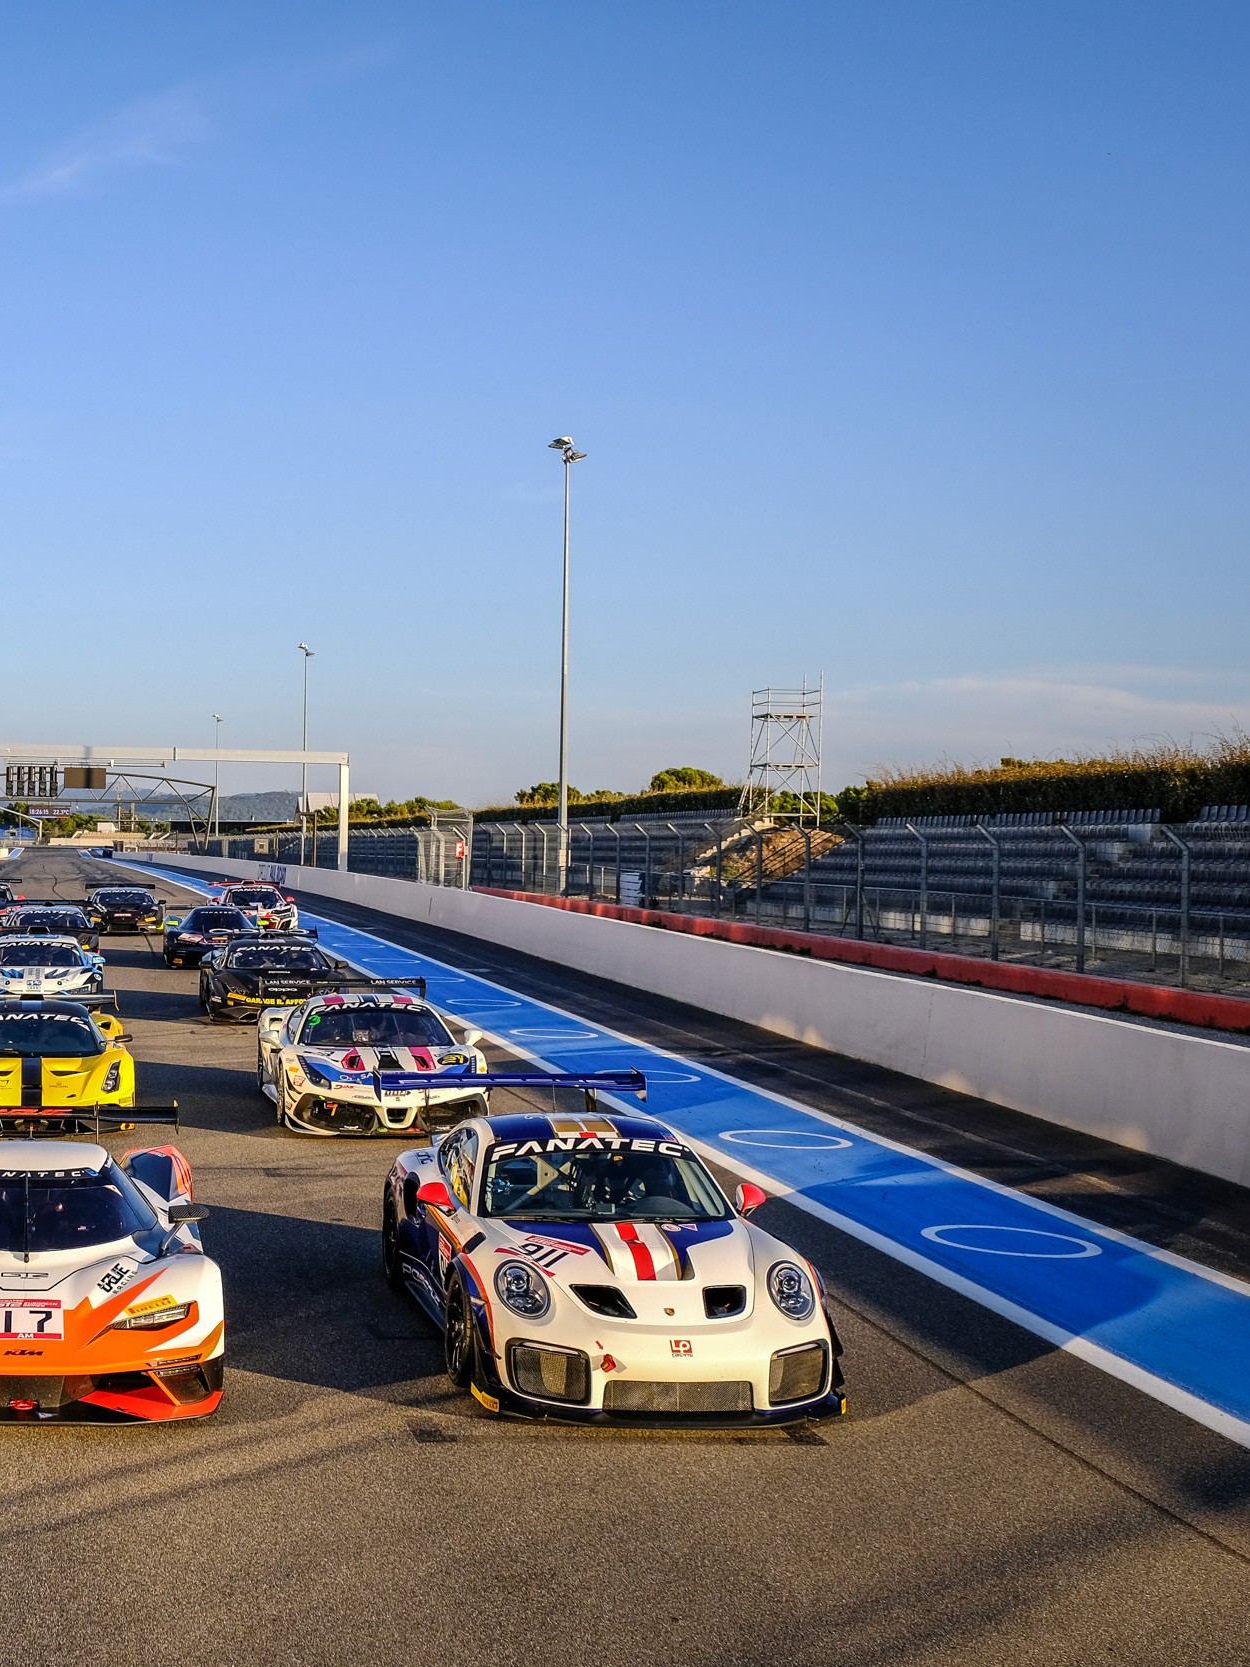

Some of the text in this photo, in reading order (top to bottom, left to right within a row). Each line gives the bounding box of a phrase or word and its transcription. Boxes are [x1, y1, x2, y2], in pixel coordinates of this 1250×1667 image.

[311, 1002, 426, 1015] FANATEC
[490, 1137, 690, 1162] FANATEC
[112, 1270, 138, 1294] RACING
[127, 1297, 172, 1315] PIRELLI
[3, 1310, 53, 1333] 17
